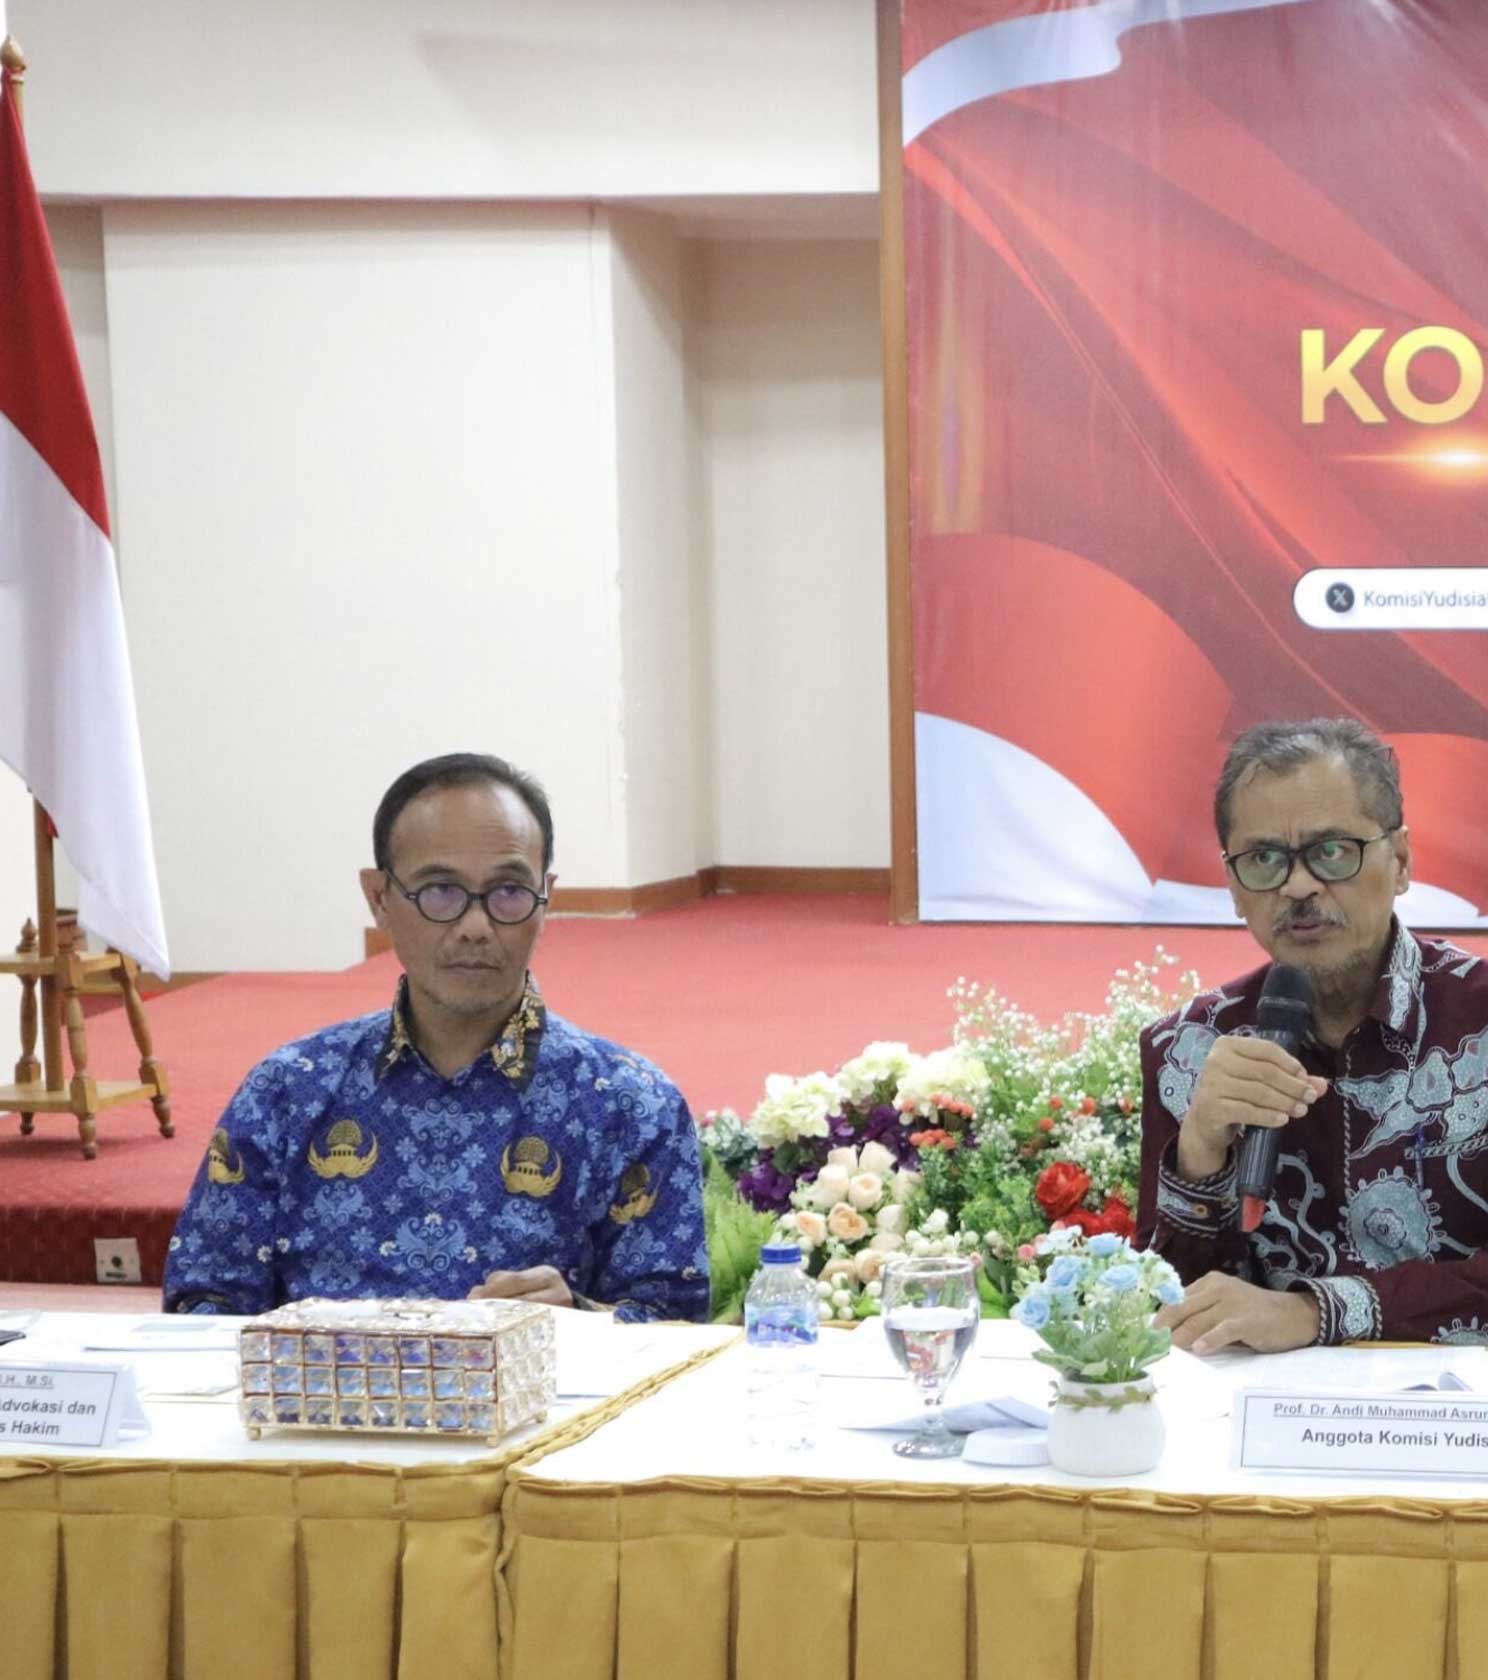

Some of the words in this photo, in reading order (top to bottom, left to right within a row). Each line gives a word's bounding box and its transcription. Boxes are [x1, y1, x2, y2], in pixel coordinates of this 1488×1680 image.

[67, 1400, 96, 1415] dan
[1274, 1403, 1305, 1416] Prof.
[1310, 1405, 1328, 1416] Dr.
[1332, 1405, 1363, 1417] Andi
[1367, 1406, 1447, 1419] Muhammad
[11, 1420, 60, 1436] Hakim
[1301, 1428, 1373, 1446] Anggota
[1379, 1430, 1438, 1446] Komisi
